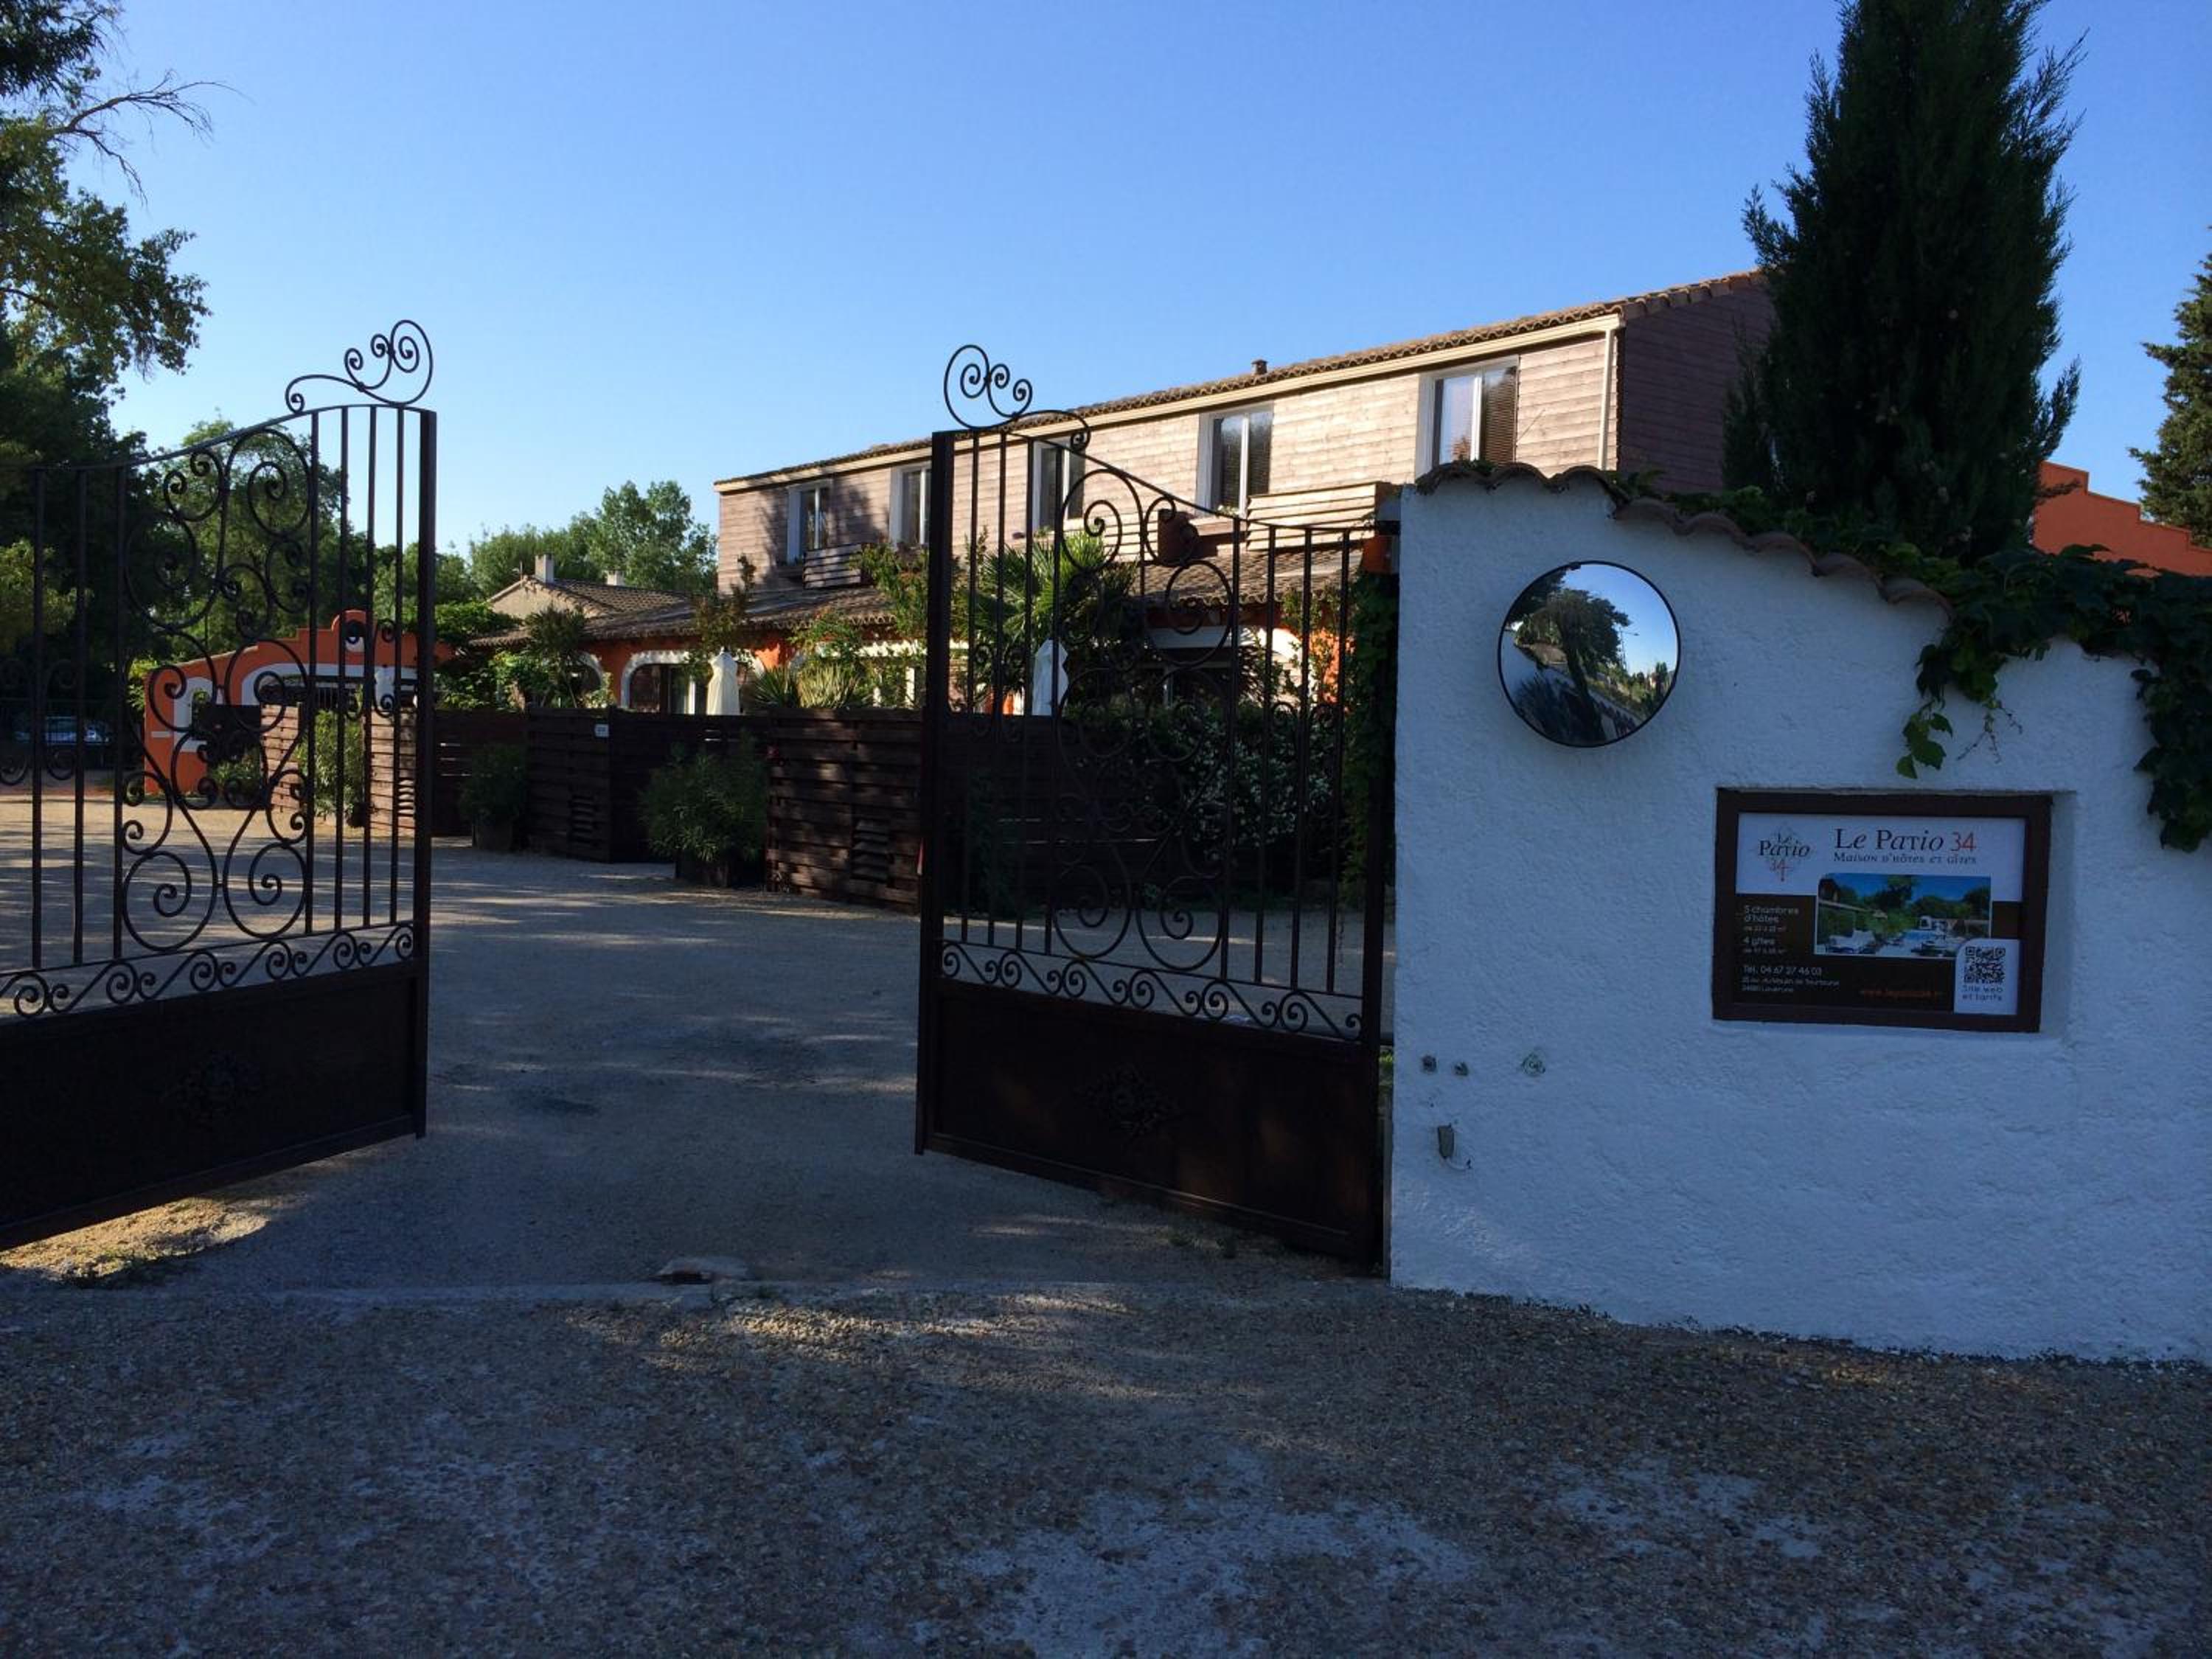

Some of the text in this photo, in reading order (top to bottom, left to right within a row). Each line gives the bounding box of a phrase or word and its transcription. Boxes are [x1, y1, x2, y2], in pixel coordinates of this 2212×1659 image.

[1834, 828, 1977, 852] Le Patio 34
[1759, 839, 1811, 857] Patio
[1833, 851, 1878, 862] Maison
[1751, 905, 1799, 915] chambres
